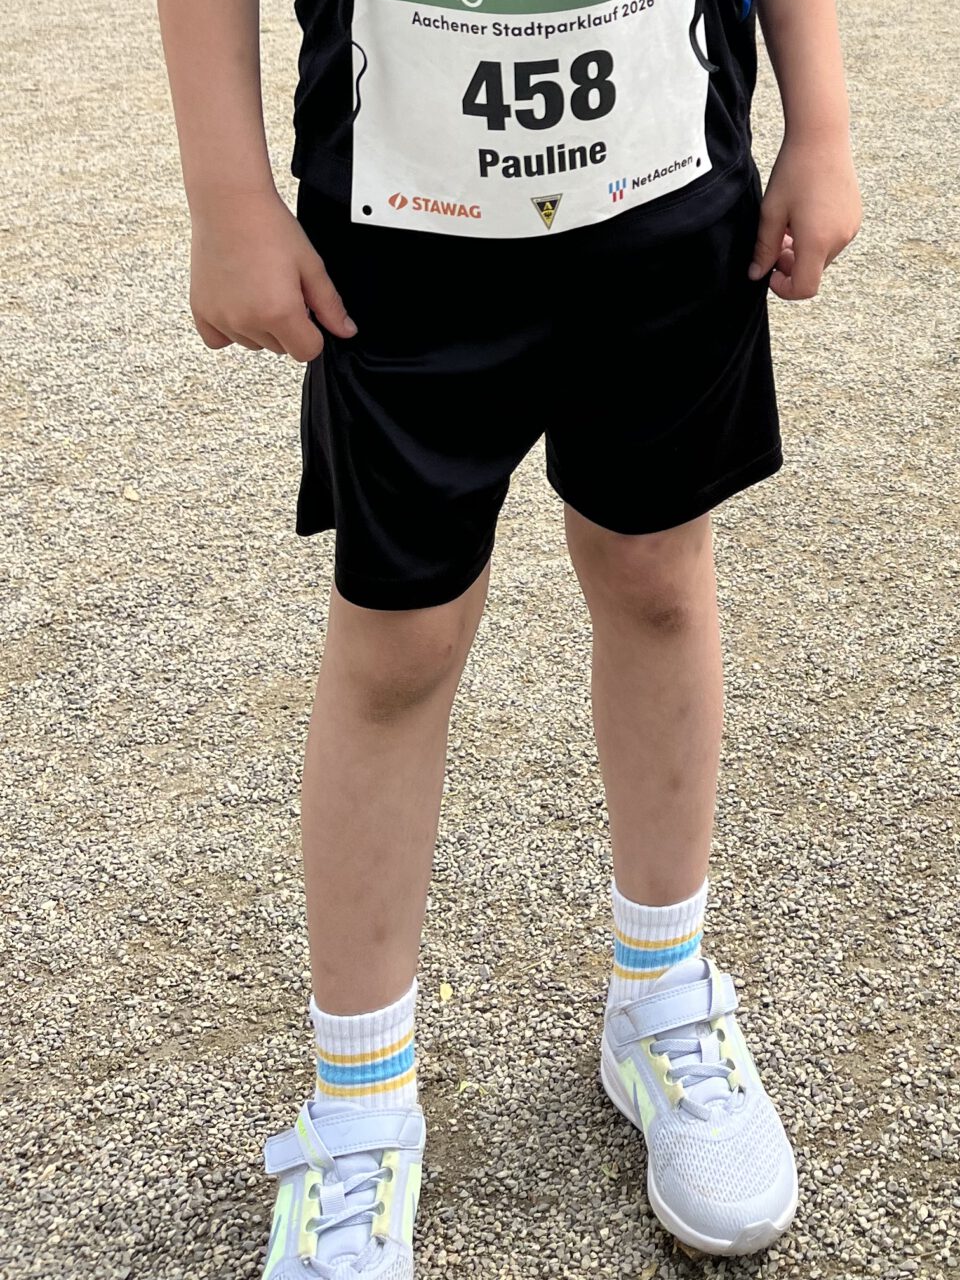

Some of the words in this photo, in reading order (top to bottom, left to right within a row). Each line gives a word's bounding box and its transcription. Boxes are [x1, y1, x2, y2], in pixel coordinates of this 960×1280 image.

[411, 11, 487, 36] Aachener
[492, 8, 620, 39] Stadtparklauf
[462, 50, 617, 131] 458
[478, 140, 608, 179] Pauline
[631, 154, 694, 190] NetAachen
[412, 196, 482, 219] STAWAG
